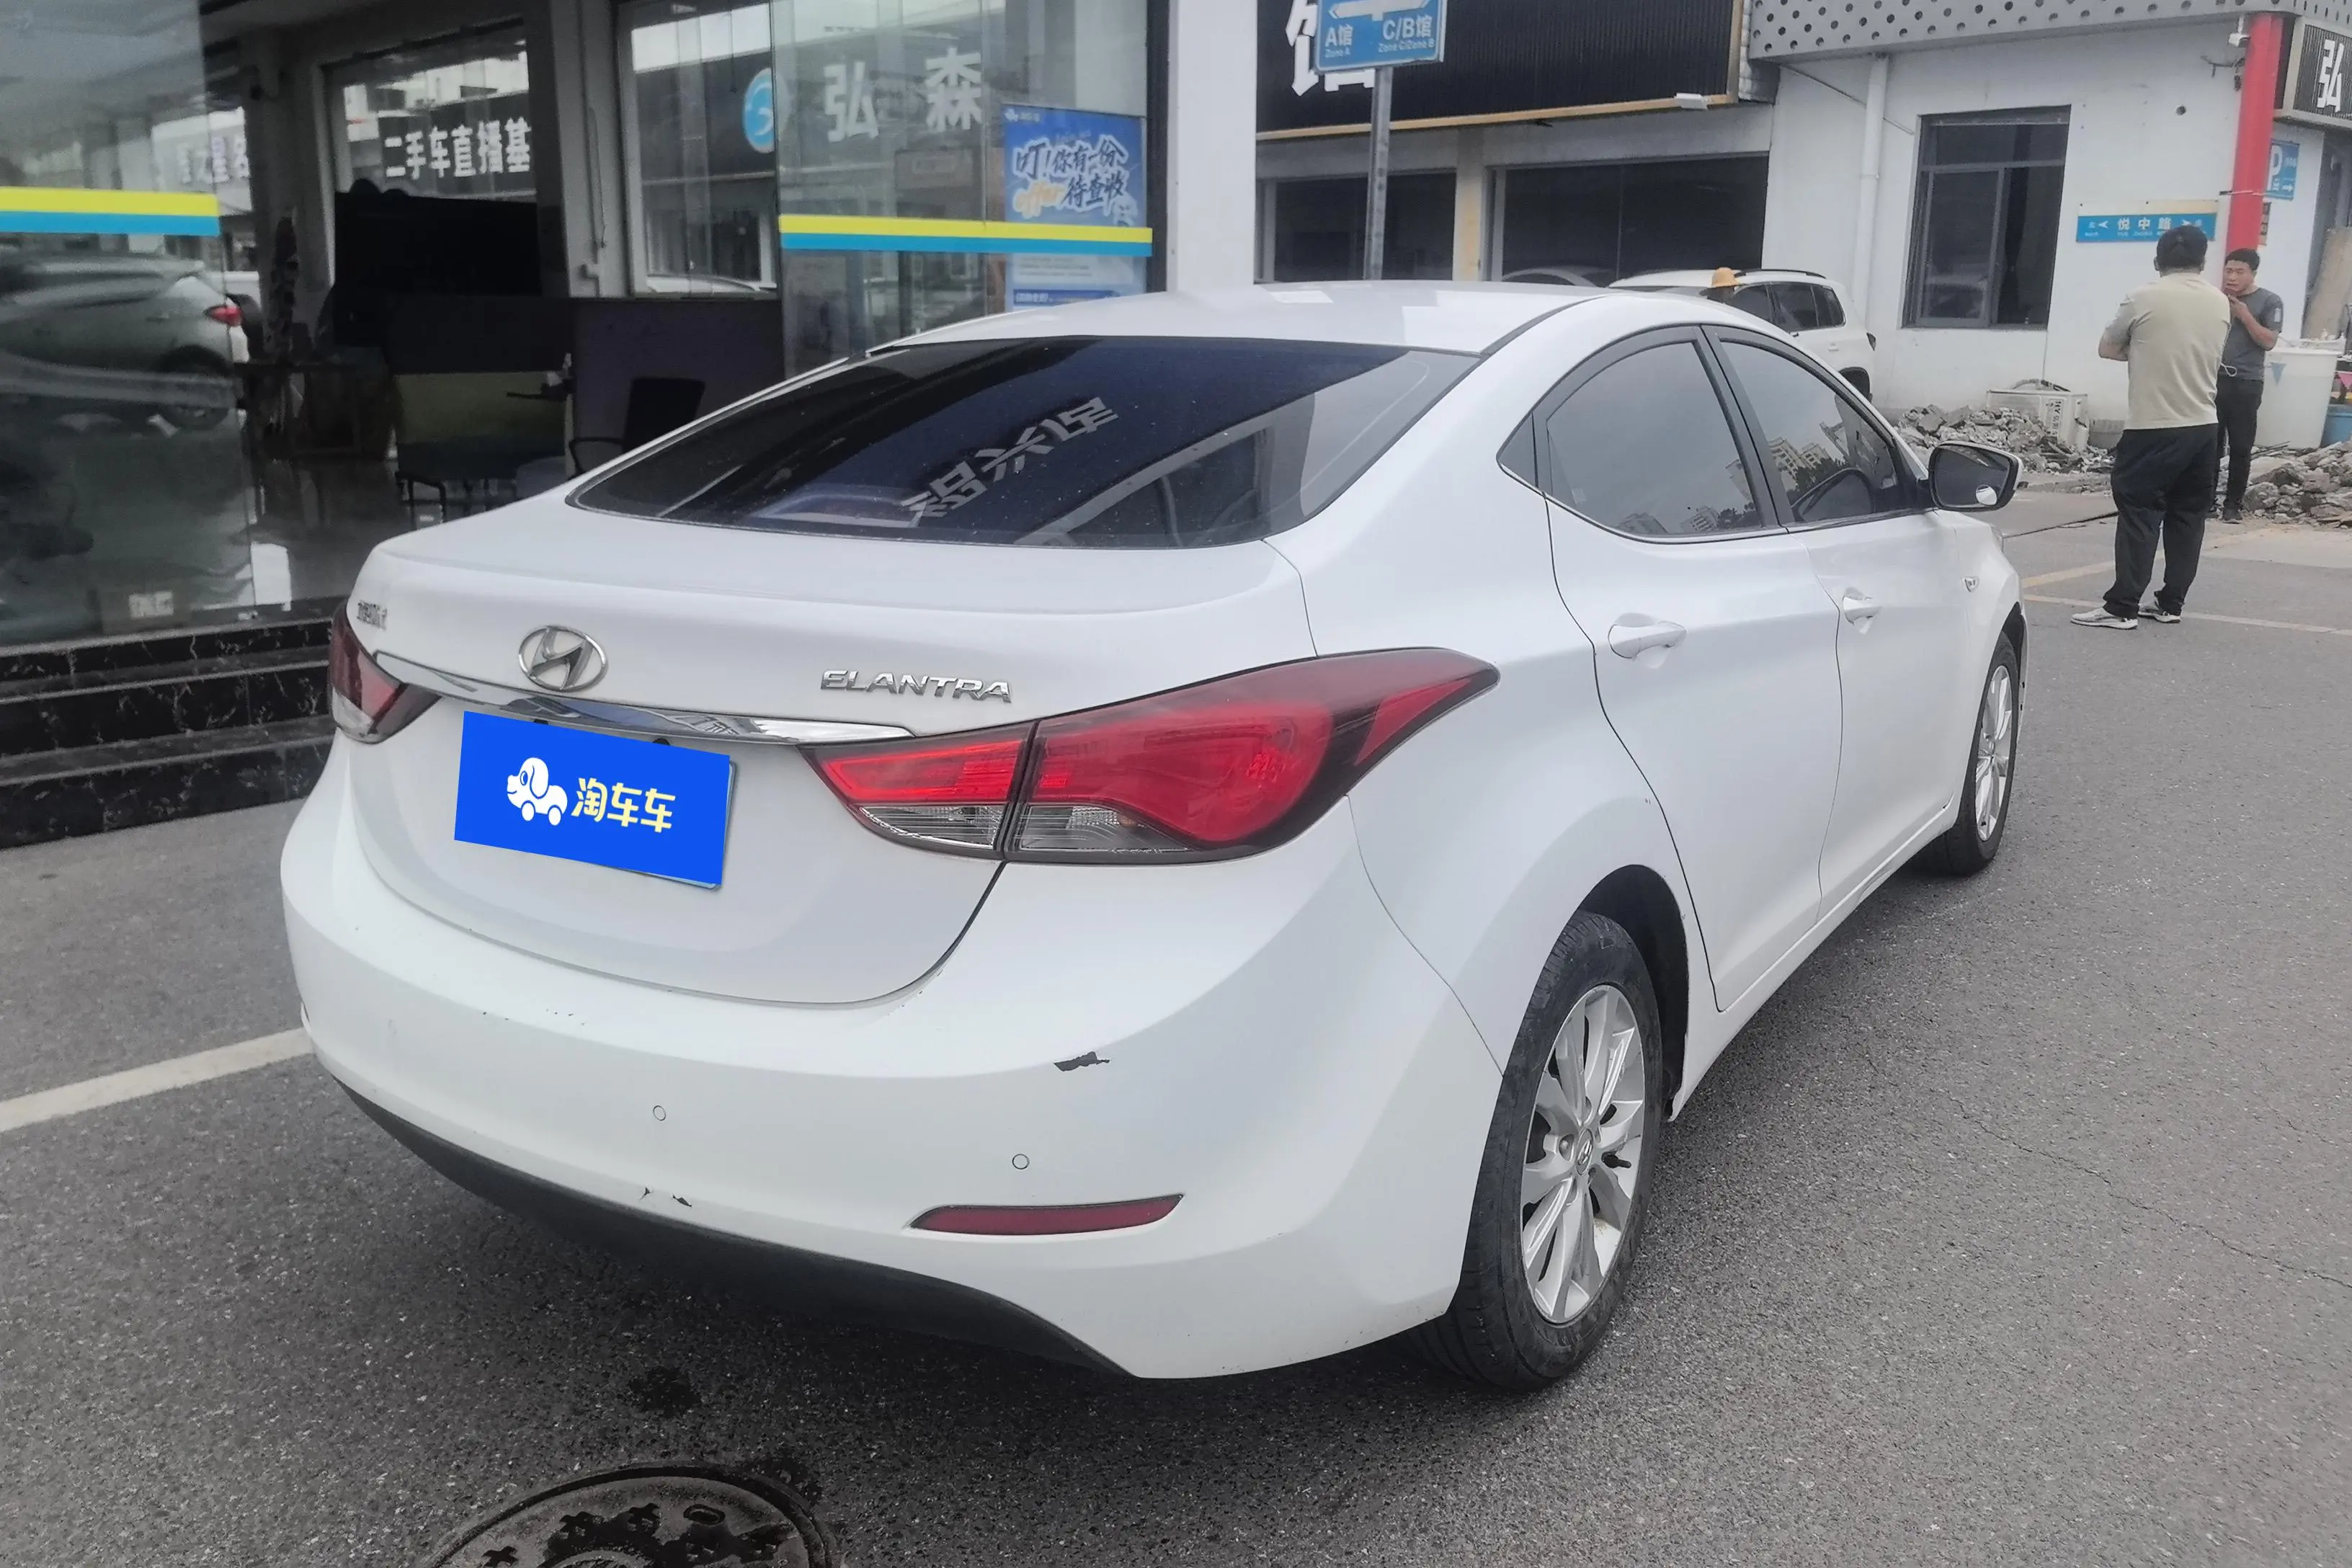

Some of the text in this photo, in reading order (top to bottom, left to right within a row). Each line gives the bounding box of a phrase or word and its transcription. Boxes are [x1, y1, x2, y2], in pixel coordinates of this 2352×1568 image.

[1324, 24, 1353, 48] A馆
[1382, 14, 1433, 41] C/B馆
[824, 46, 981, 143] 弘森
[384, 116, 533, 180] 二手车直播基
[2267, 146, 2282, 190] P
[821, 669, 1012, 703] ELANTRA
